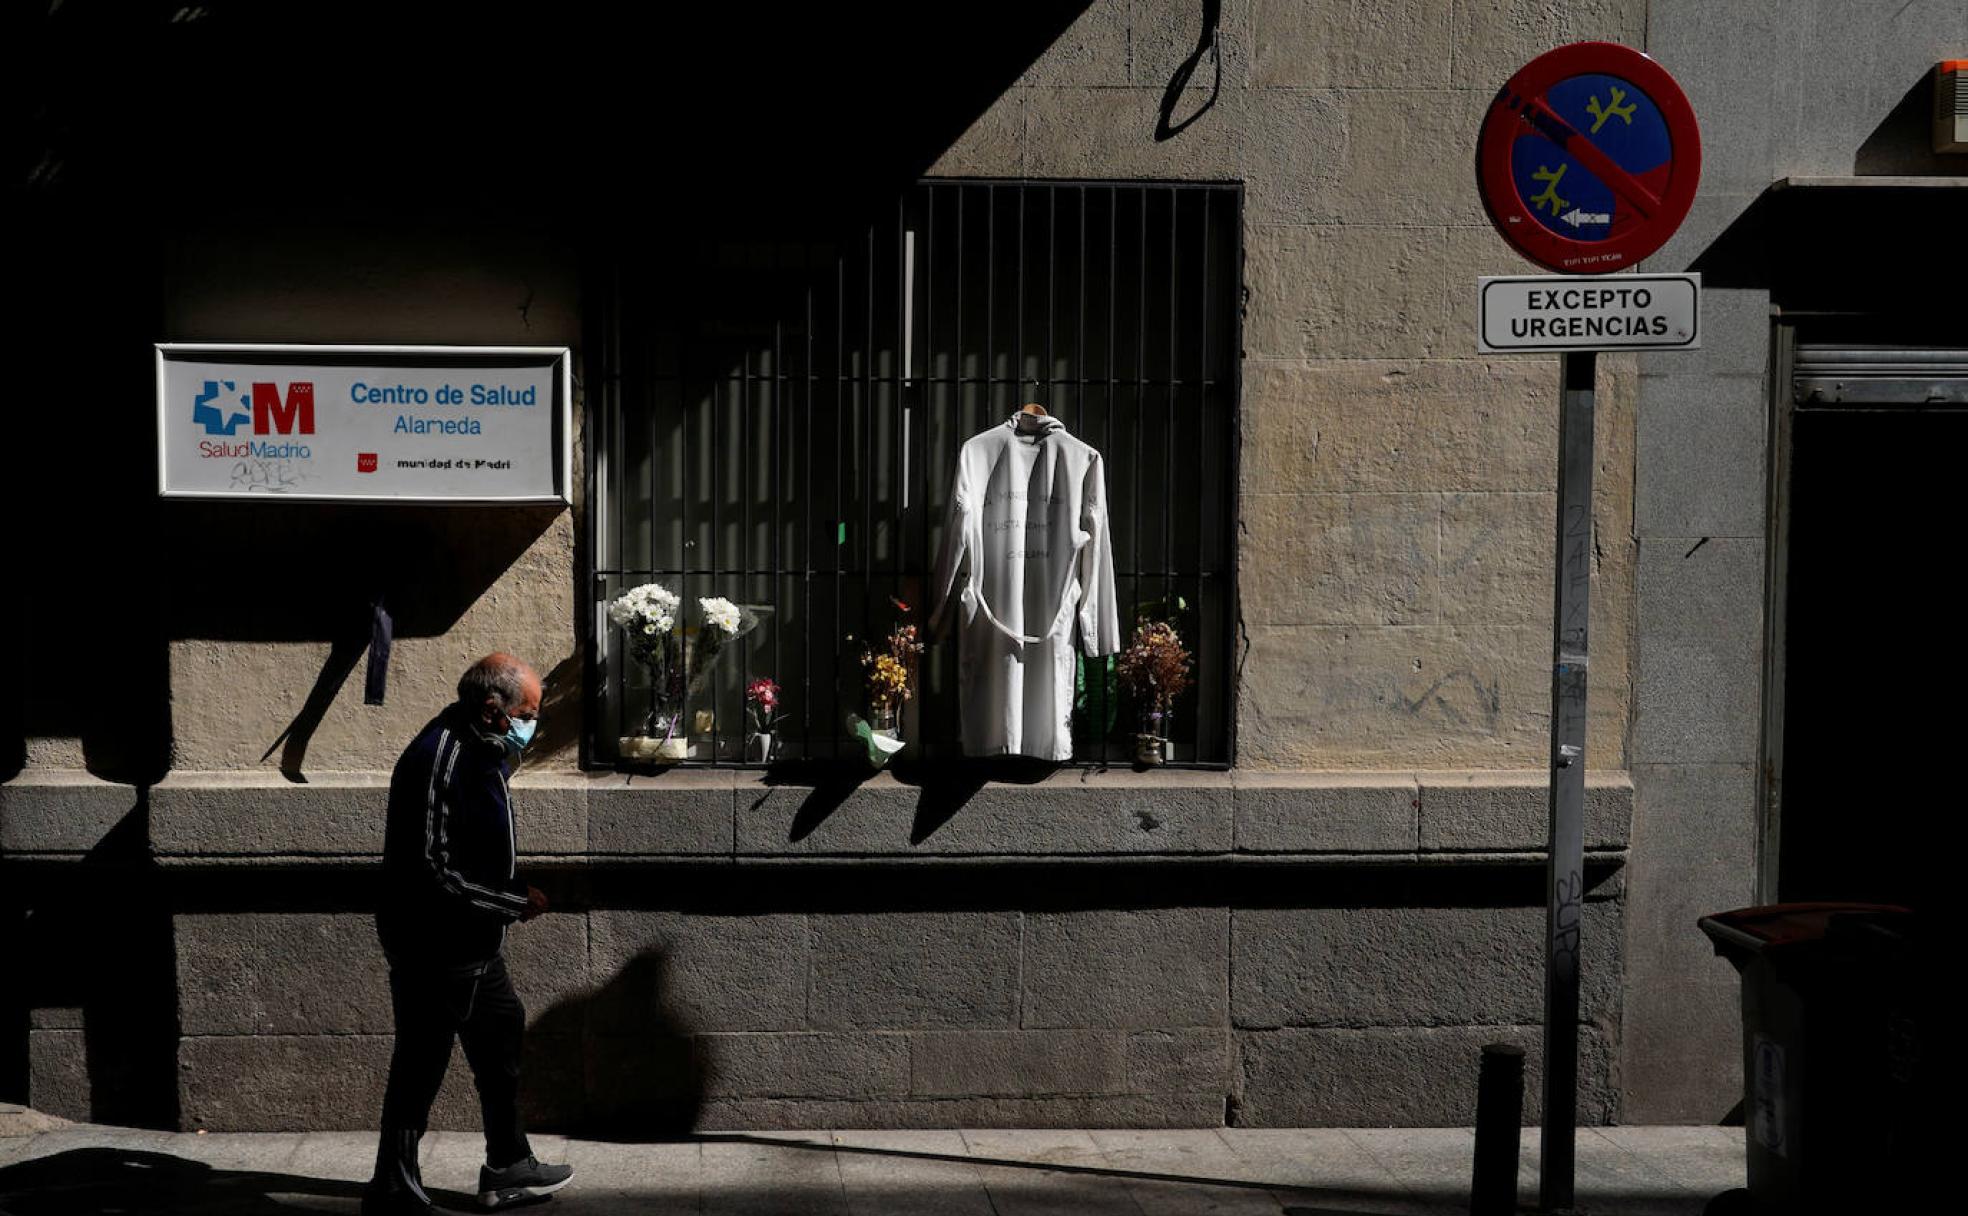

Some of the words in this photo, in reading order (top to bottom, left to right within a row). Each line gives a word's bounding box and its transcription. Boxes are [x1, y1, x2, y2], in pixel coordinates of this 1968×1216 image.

[1528, 288, 1651, 310] EXCEPTO
[1511, 315, 1668, 337] URGENCIAS
[350, 382, 429, 405] Centro
[434, 384, 464, 405] de
[470, 384, 536, 406] Salud
[394, 415, 482, 435] Alameda
